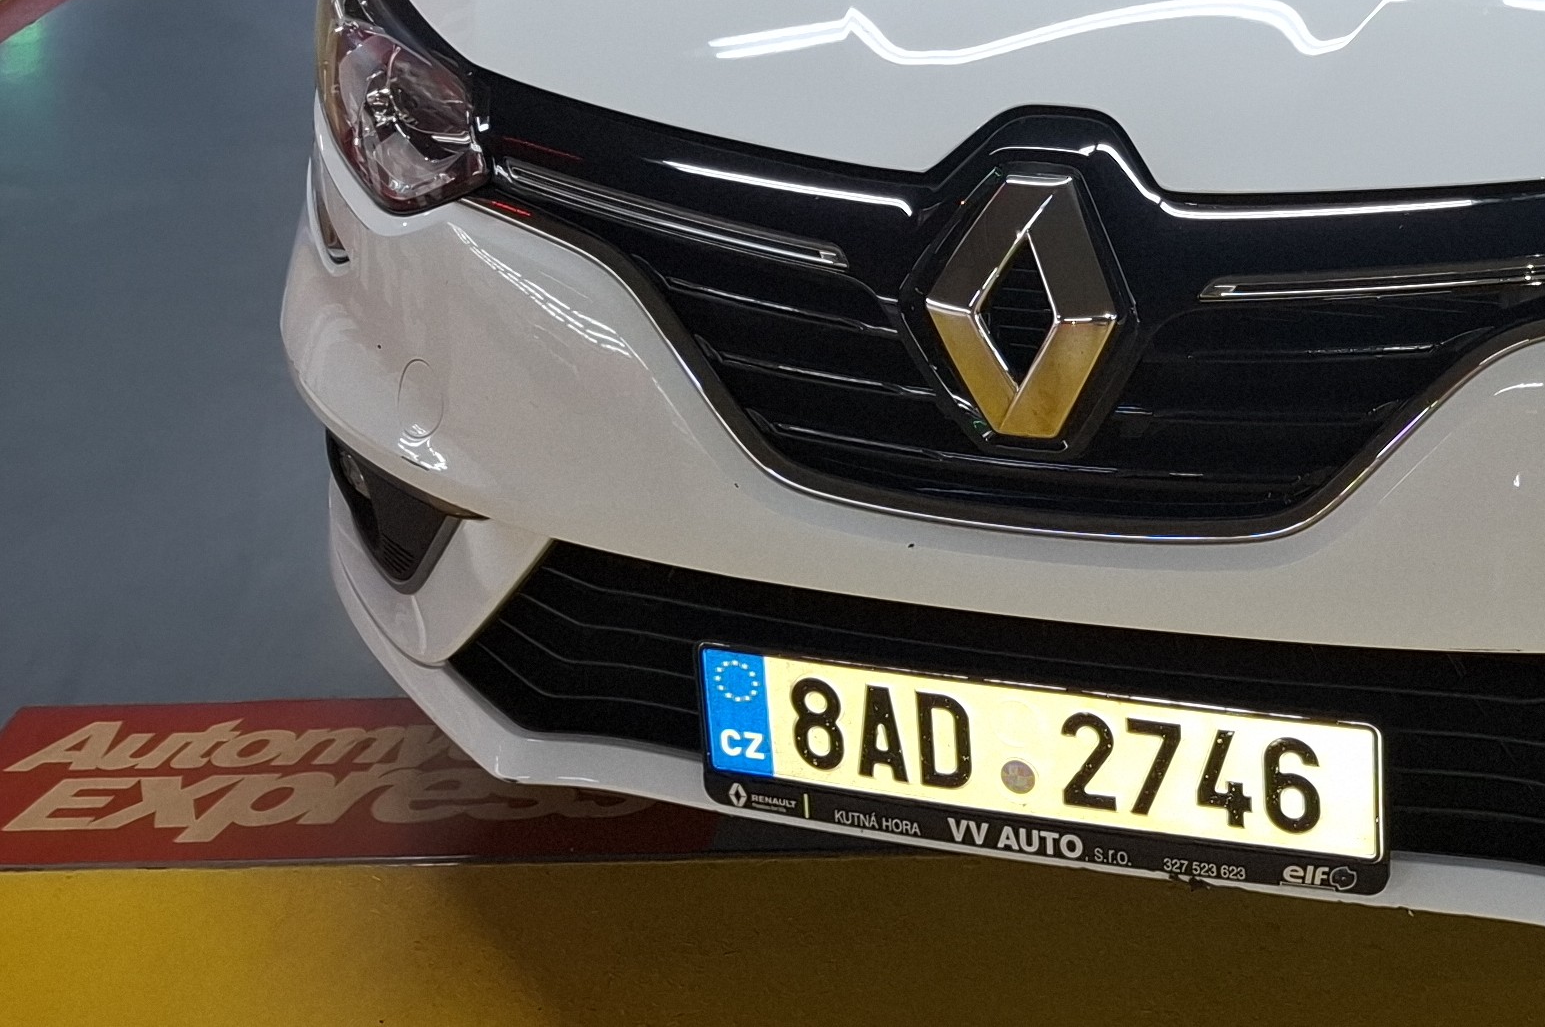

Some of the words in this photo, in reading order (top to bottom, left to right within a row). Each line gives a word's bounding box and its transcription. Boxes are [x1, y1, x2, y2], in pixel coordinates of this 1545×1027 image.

[719, 728, 766, 761] CZ
[788, 676, 973, 791] 8AD
[1058, 710, 1322, 835] 2746
[751, 794, 797, 809] RENAULT
[834, 809, 880, 830] KUTNÁ
[882, 818, 921, 836] HORA
[946, 817, 989, 846] VV
[1163, 857, 1188, 873] 327
[1192, 860, 1217, 877] 523
[1220, 864, 1246, 880] 623
[1282, 864, 1330, 886] elf
